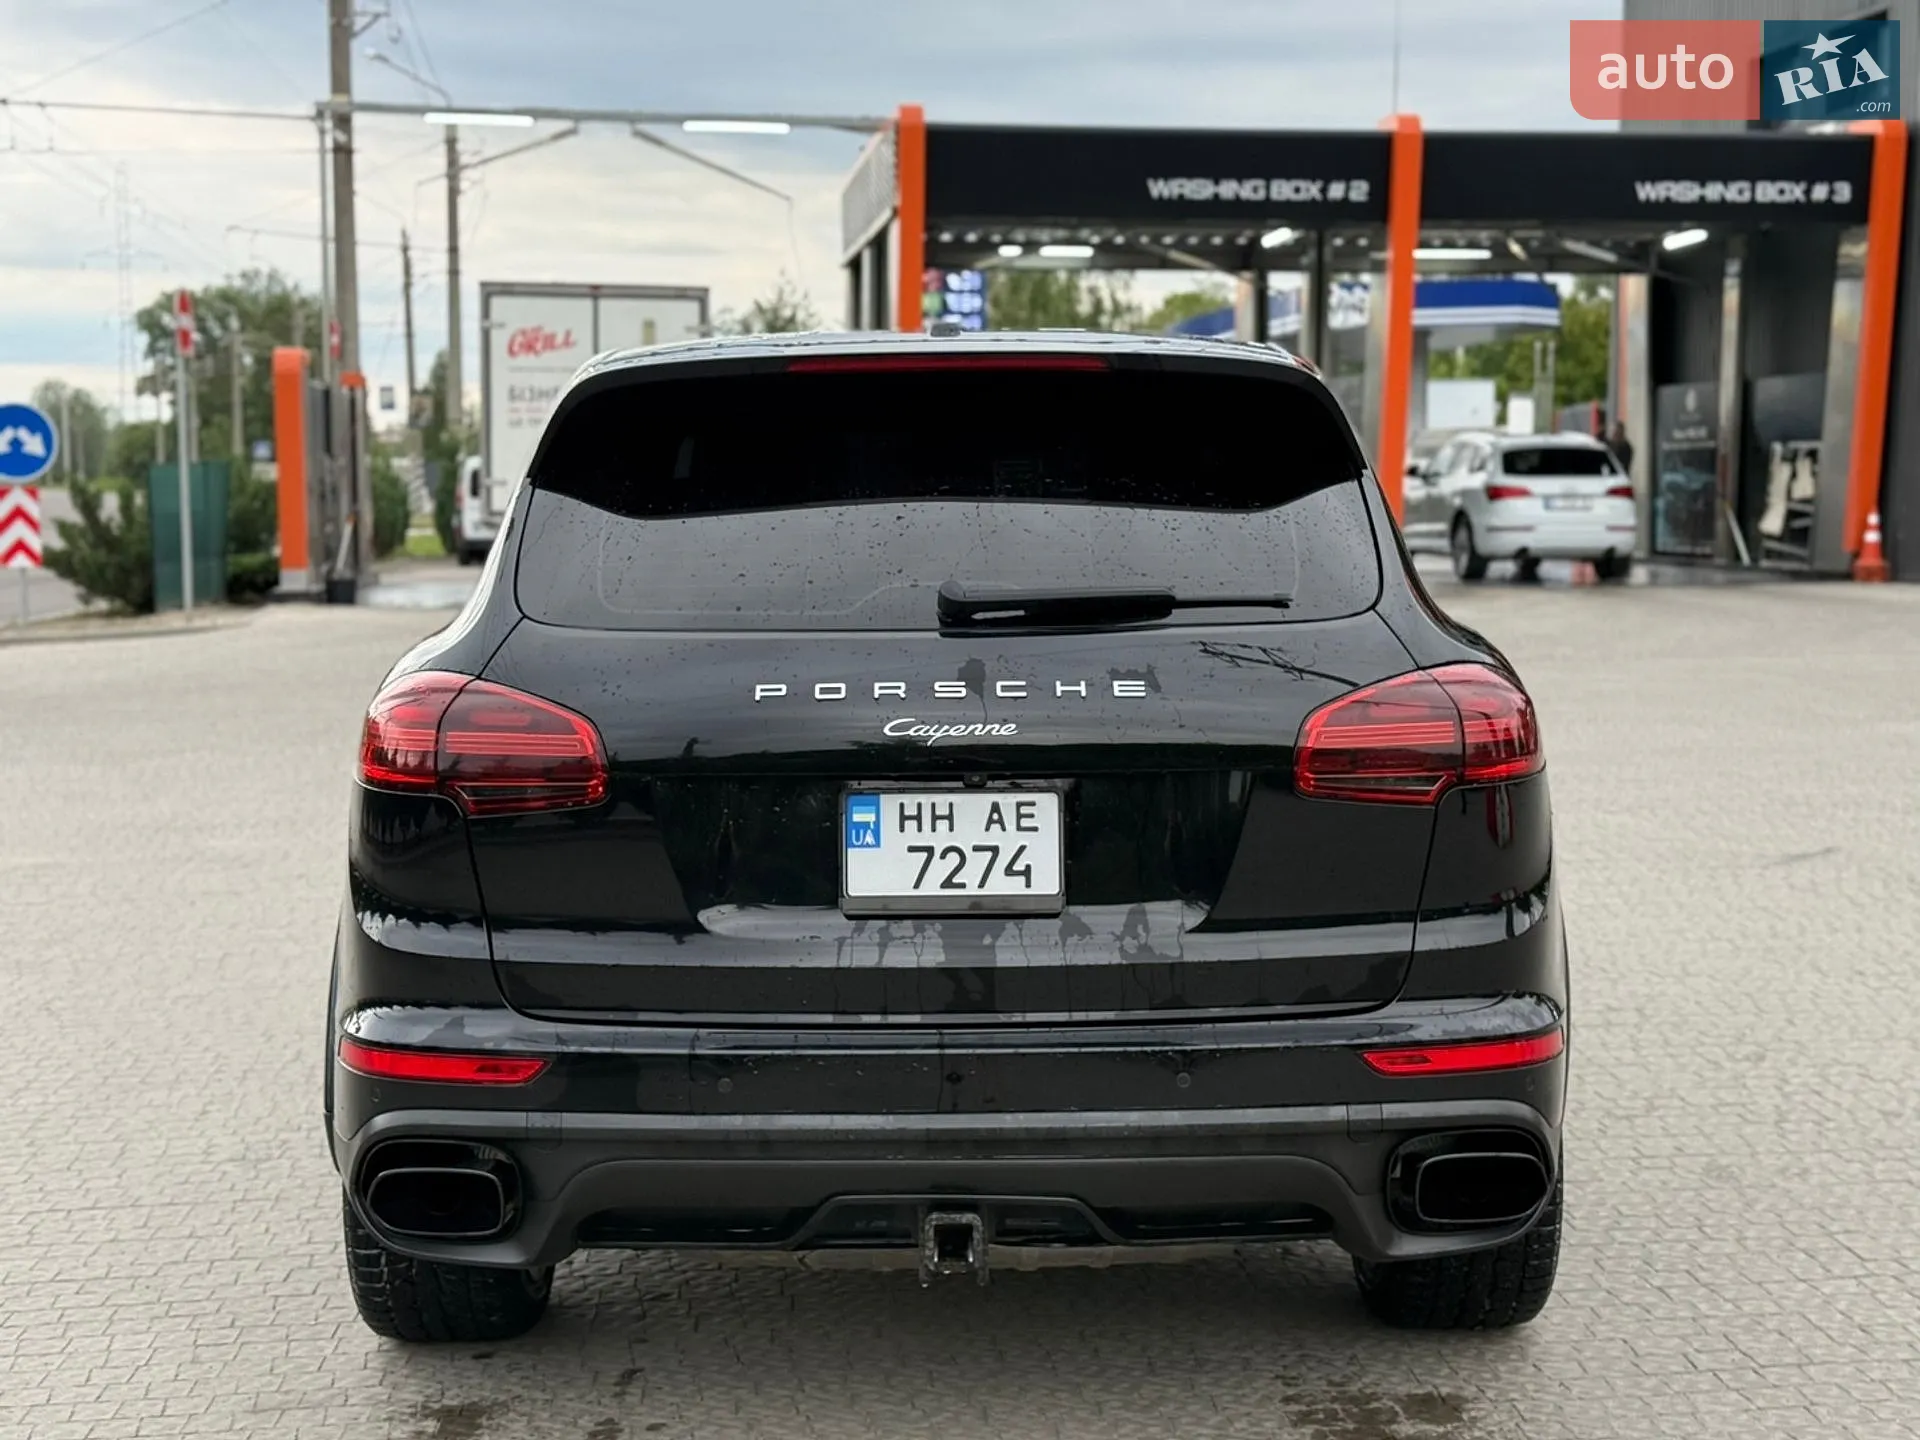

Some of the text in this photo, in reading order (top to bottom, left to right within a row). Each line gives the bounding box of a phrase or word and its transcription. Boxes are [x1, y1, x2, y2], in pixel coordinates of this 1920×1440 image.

[1146, 177, 1267, 201] WASHING
[1269, 178, 1323, 202] BOX
[1634, 179, 1752, 203] WASHING
[1754, 179, 1807, 203] BOX
[754, 680, 1148, 701] PORSCHE
[883, 717, 1018, 746] Cayenne
[899, 801, 1040, 833] HH AE
[852, 829, 876, 845] UA
[906, 844, 1032, 889] 7274
